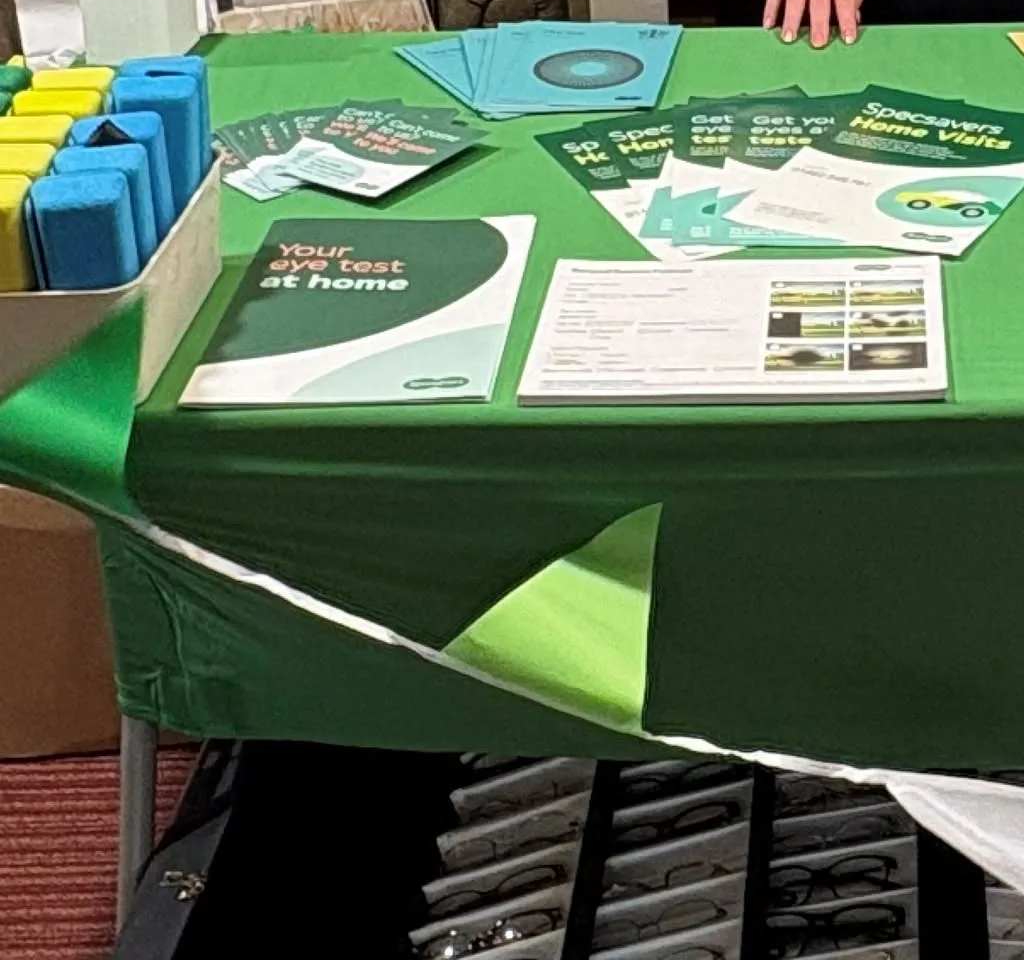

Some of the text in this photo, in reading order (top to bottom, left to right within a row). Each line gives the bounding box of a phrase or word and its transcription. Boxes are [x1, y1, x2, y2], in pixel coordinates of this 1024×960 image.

[691, 114, 734, 124] Get
[753, 115, 796, 125] Get
[862, 102, 1005, 135] Specsavers
[750, 126, 803, 136] eyes
[849, 116, 929, 139] Home
[937, 128, 1013, 150] Visits
[279, 243, 354, 258] Your
[268, 258, 407, 274] eye test
[259, 274, 410, 291] at home
